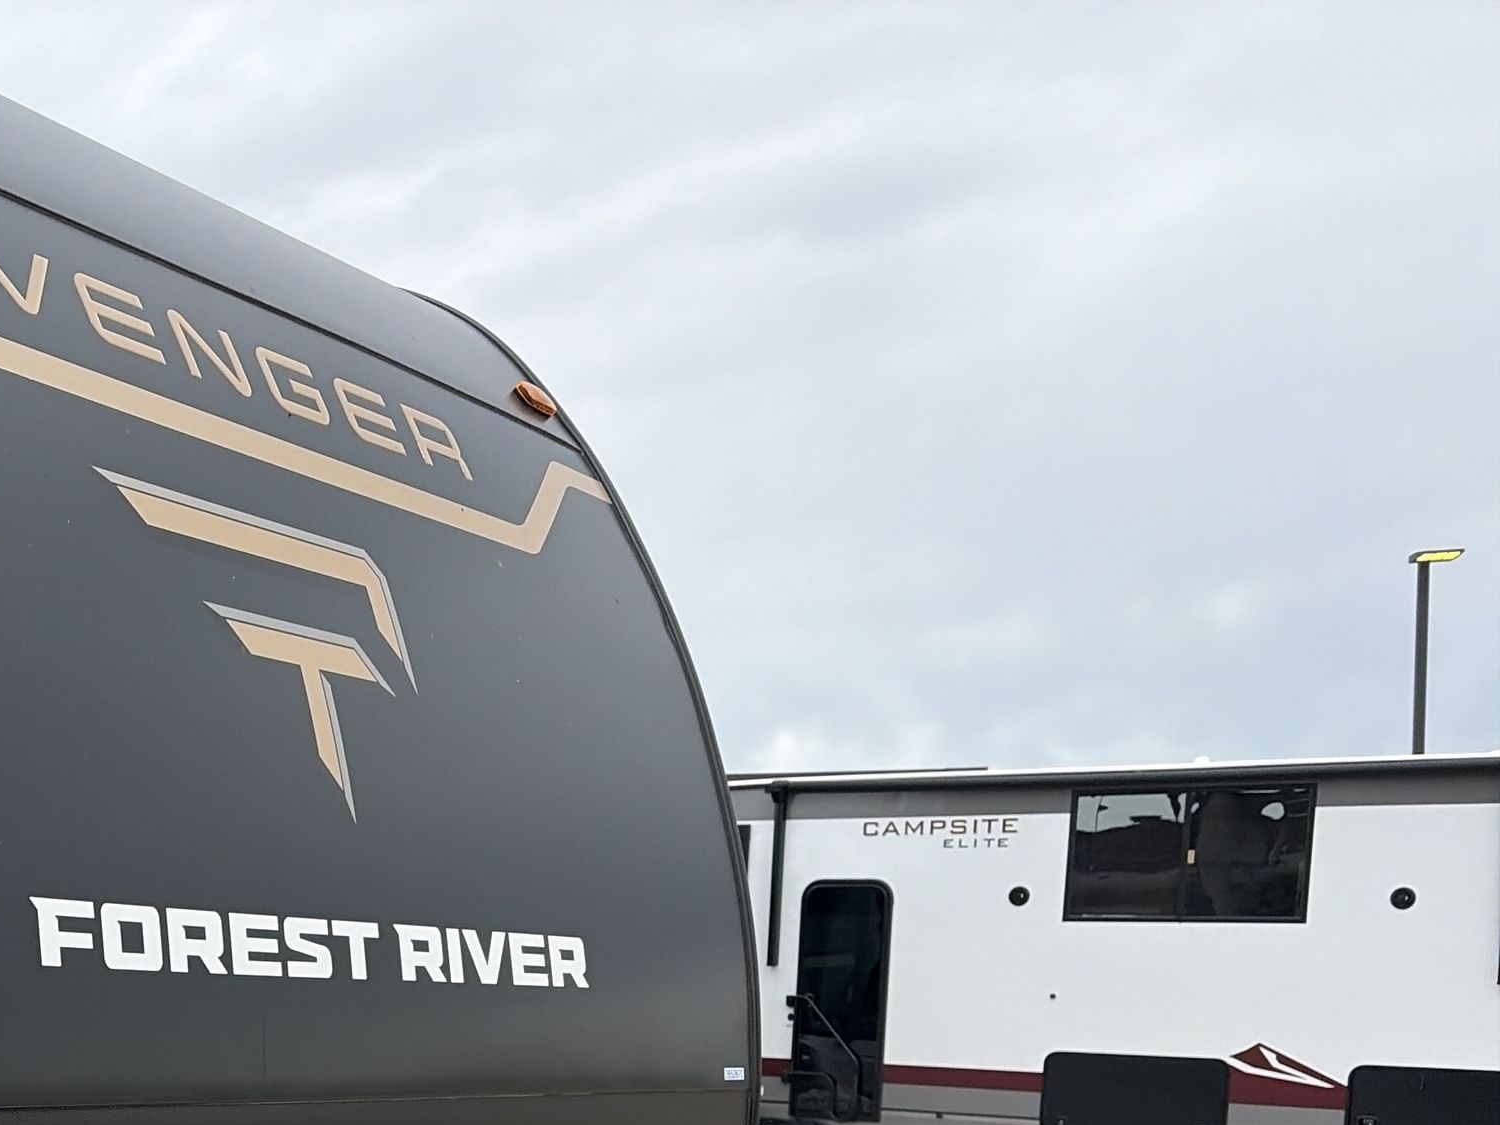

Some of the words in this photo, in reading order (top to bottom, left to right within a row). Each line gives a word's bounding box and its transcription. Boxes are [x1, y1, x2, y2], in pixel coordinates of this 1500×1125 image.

[863, 817, 1019, 836] CAMPSITE
[943, 838, 1009, 848] ELITE
[29, 896, 380, 980] FOREST
[392, 922, 590, 989] RIVER
